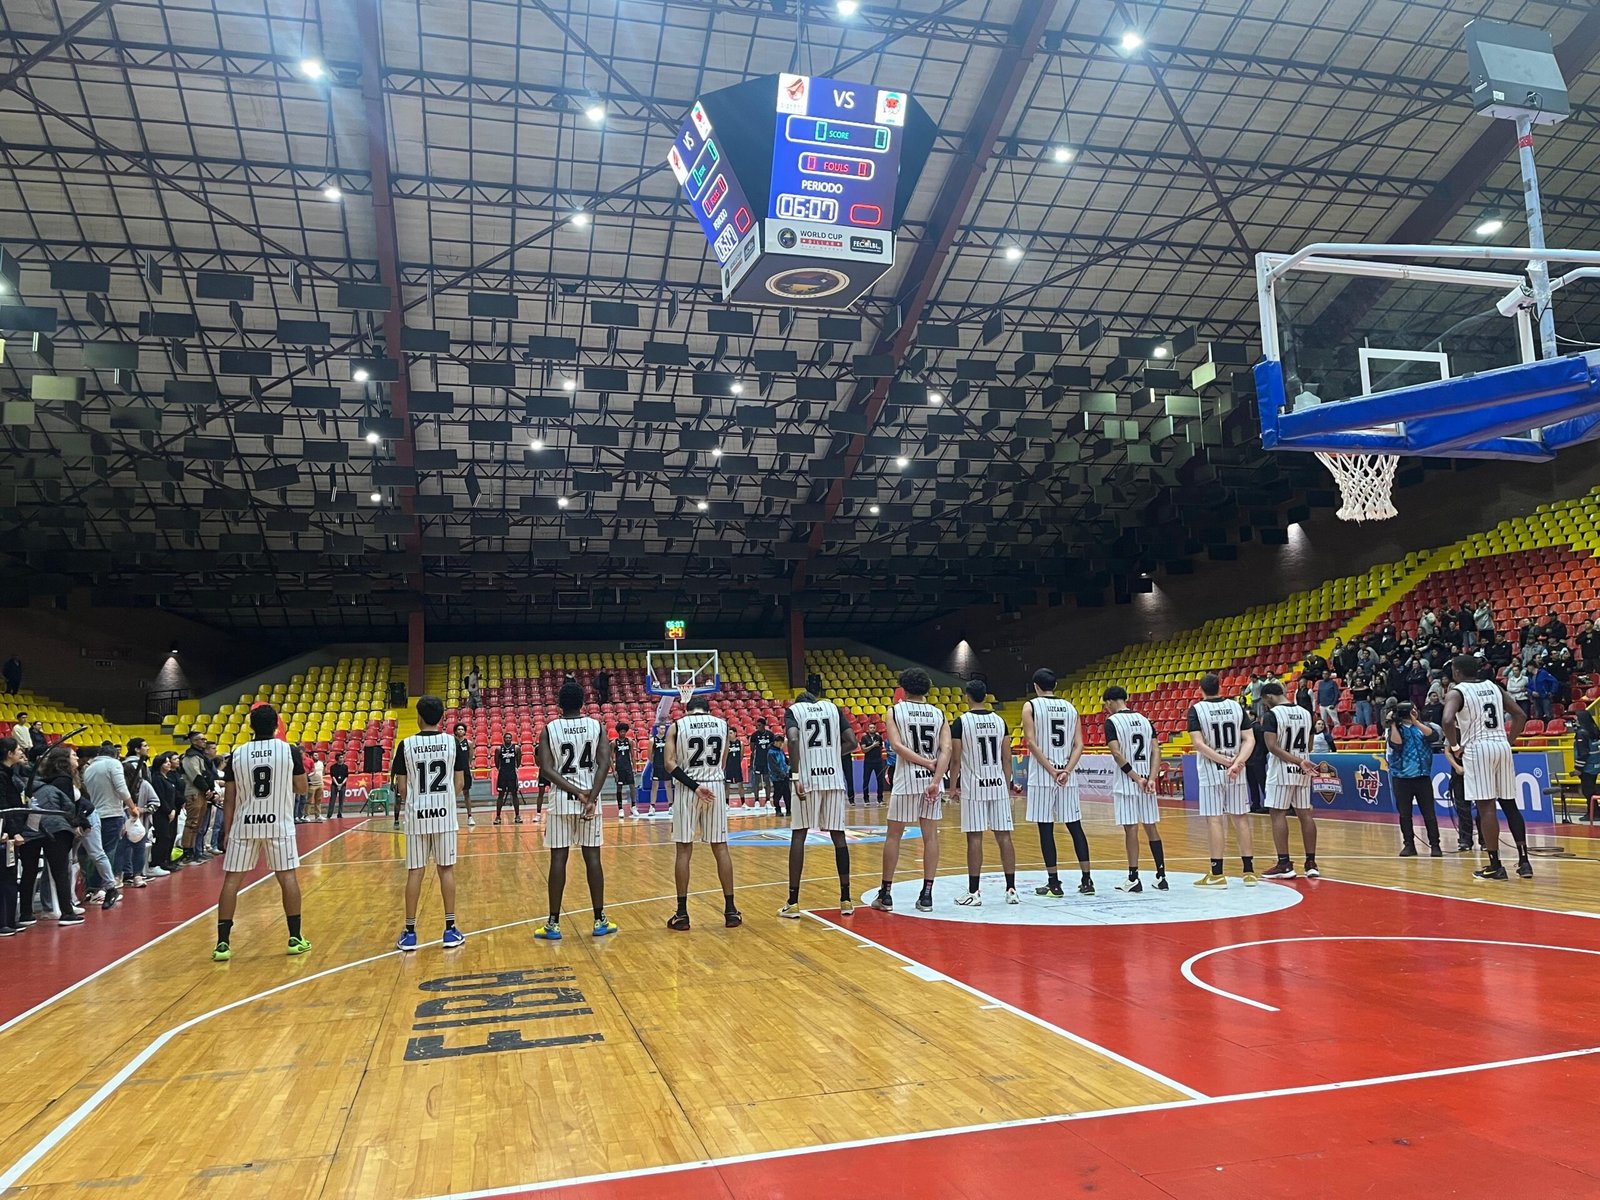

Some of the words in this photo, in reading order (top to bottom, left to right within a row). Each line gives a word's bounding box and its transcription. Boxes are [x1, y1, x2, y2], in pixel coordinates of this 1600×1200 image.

[833, 89, 855, 109] VS
[829, 130, 849, 139] SCORE
[824, 161, 849, 172] FOULS
[801, 180, 843, 194] PERIODO
[781, 196, 834, 220] 06:07
[800, 230, 826, 239] WORLD
[828, 232, 843, 240] CUP
[669, 627, 683, 638] 24
[908, 710, 933, 718] HURTADO
[1483, 703, 1498, 729] 3
[563, 726, 587, 735] RIASCOS
[689, 722, 719, 730] ANDERSON
[806, 718, 832, 748] 21
[908, 724, 935, 754] 15
[1051, 719, 1065, 747] 5
[1211, 722, 1236, 748] 10
[1285, 726, 1307, 753] 14
[413, 744, 447, 754] VELASQUEZ
[687, 736, 723, 768] 23
[977, 736, 998, 766] 11
[1131, 733, 1146, 761] 2
[250, 750, 272, 758] SOLER
[560, 741, 594, 775] 24
[416, 760, 447, 795] 12
[810, 767, 835, 777] KIMO
[915, 769, 934, 778] KIM
[252, 765, 273, 799] 8
[979, 777, 1003, 787] KIMO
[1357, 779, 1378, 789] DPB
[244, 814, 276, 825] KIMO
[417, 807, 447, 819] KIMO
